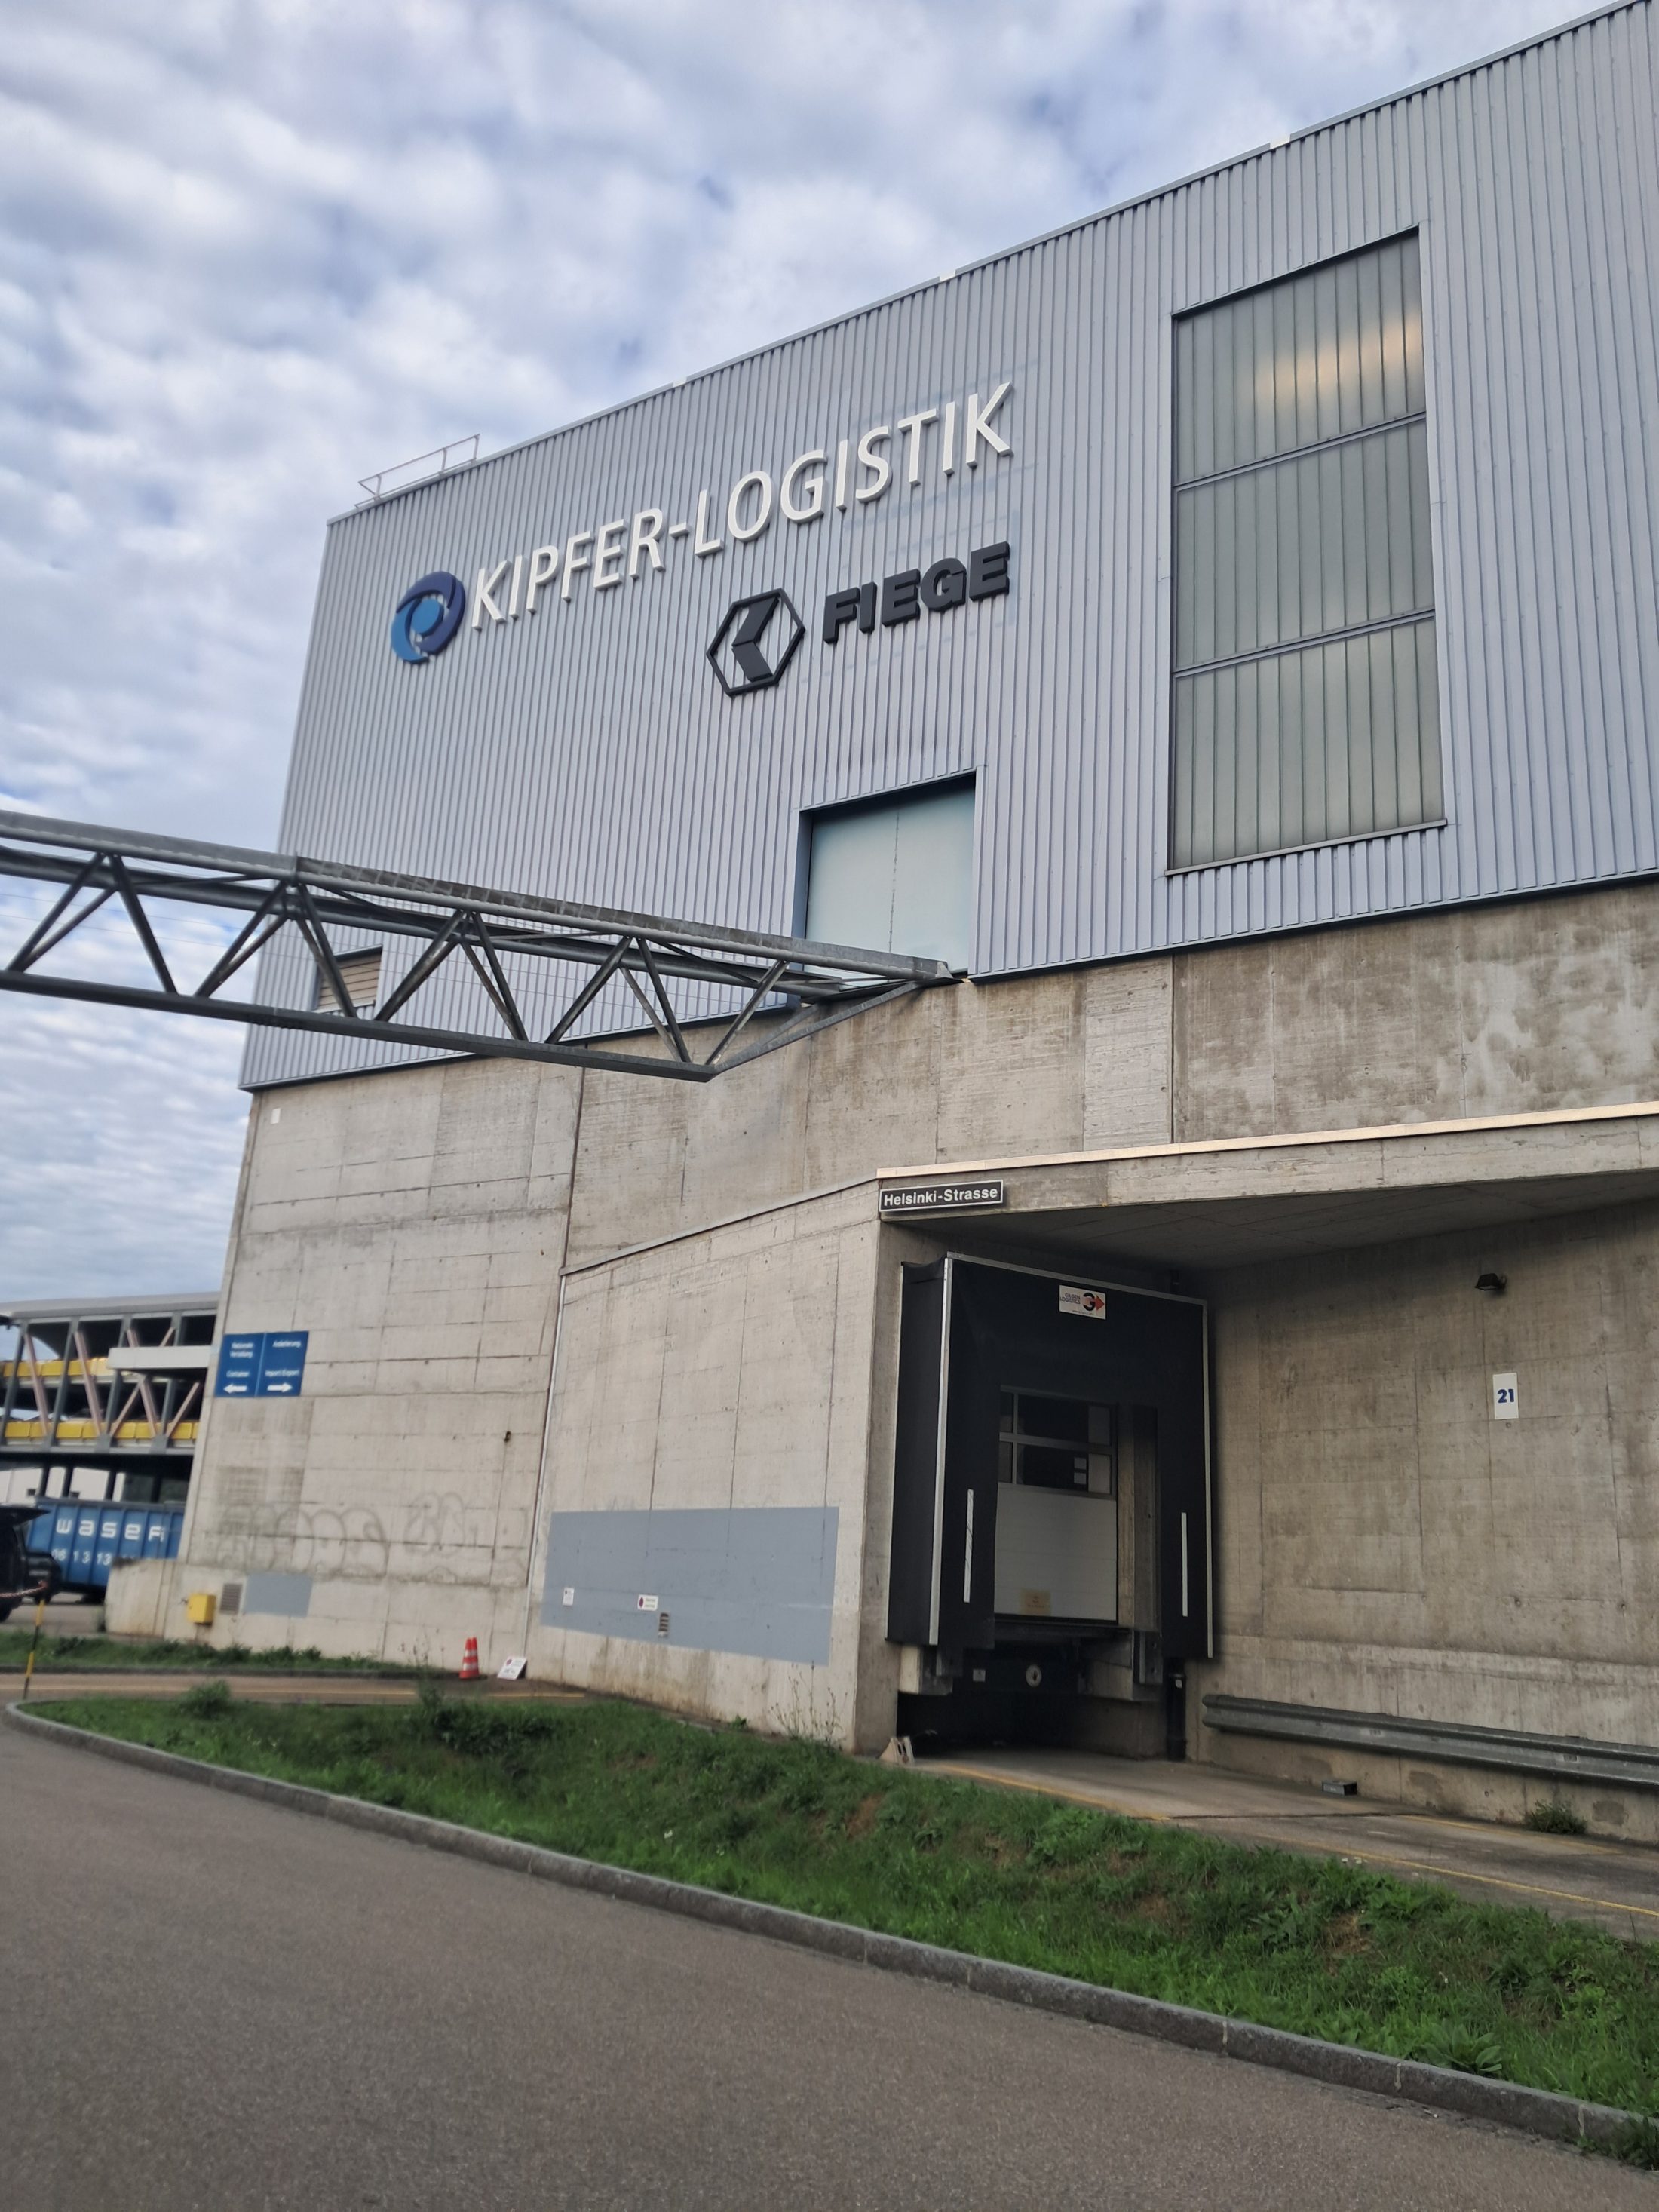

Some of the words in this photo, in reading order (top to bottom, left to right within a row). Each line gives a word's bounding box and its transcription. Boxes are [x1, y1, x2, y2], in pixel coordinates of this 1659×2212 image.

[471, 382, 1013, 630] KIPFER-LOGISTIK
[823, 541, 1010, 644] FIEGE
[883, 1188, 998, 1207] Helsinki-Strasse
[1497, 1388, 1515, 1404] 21
